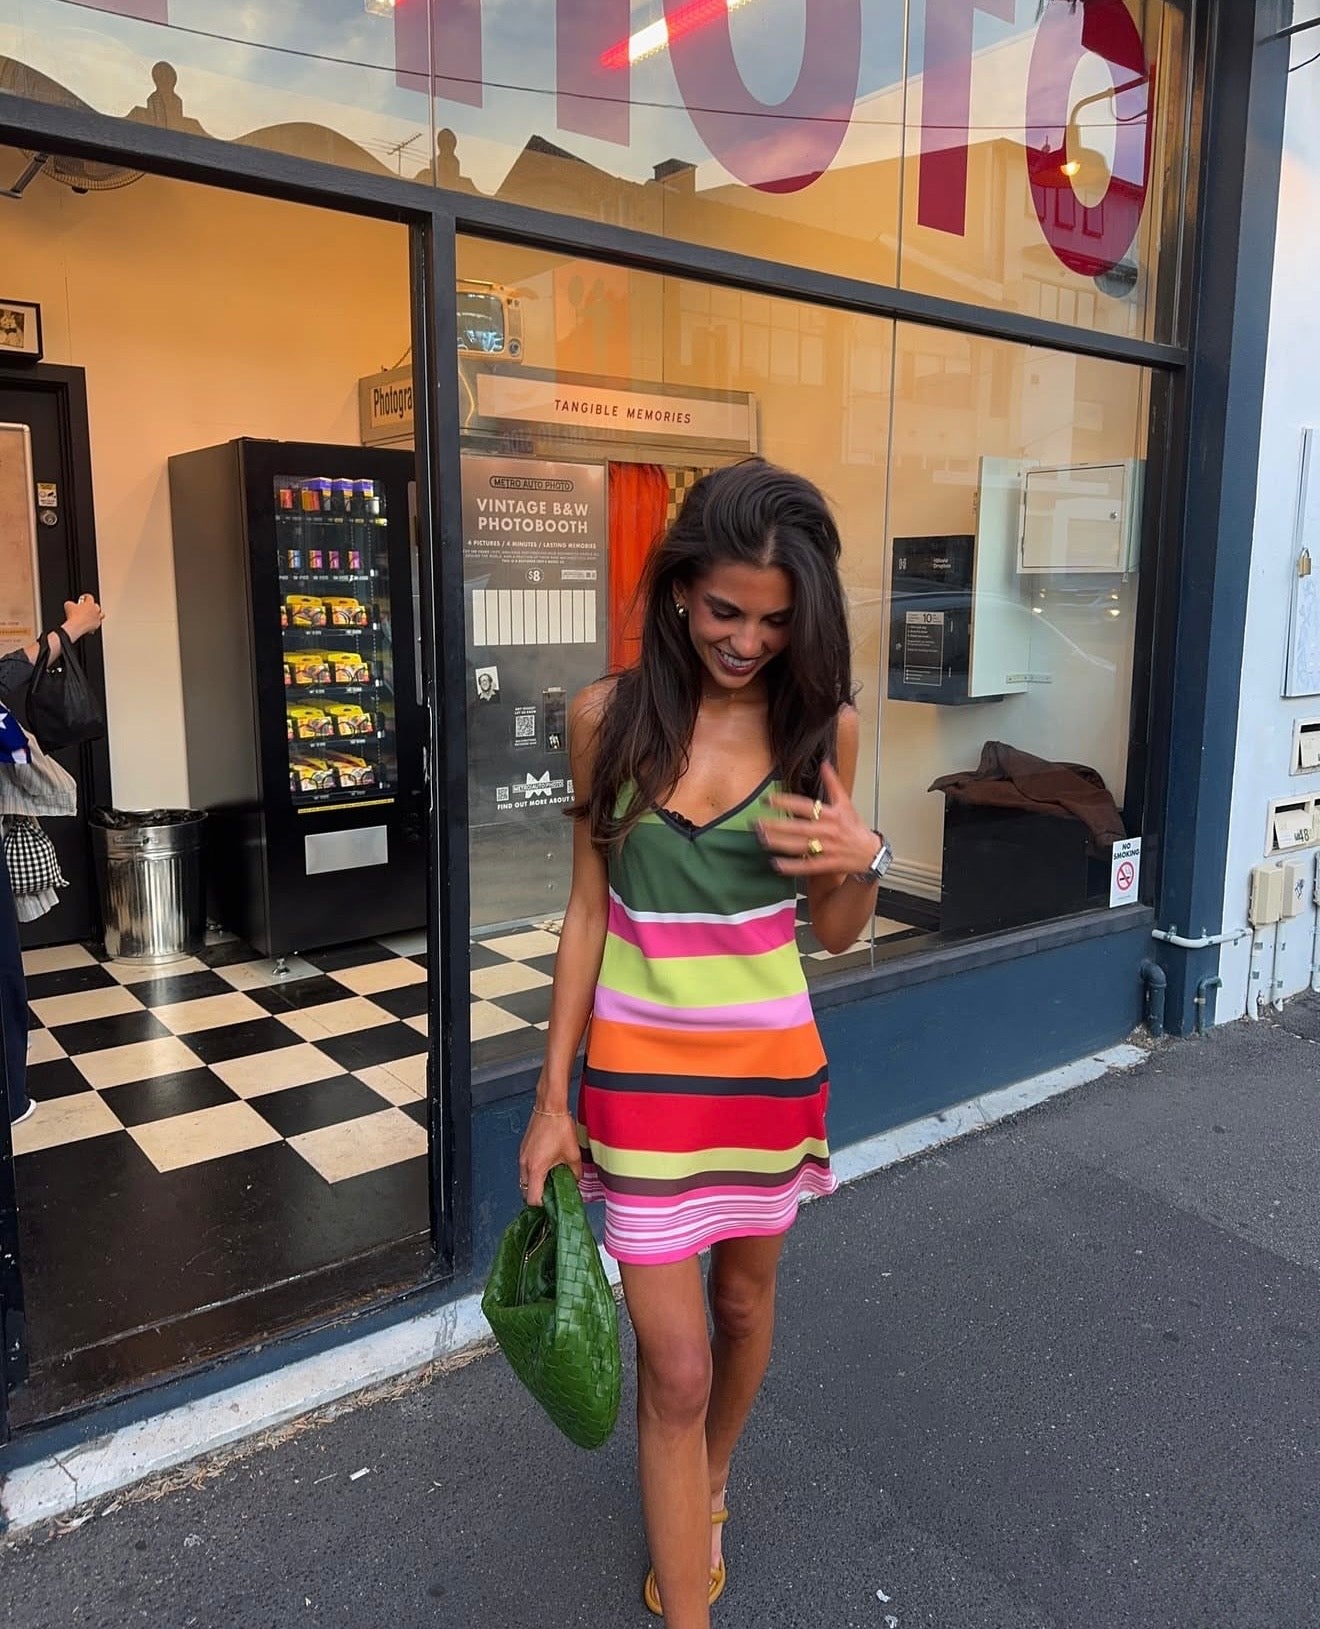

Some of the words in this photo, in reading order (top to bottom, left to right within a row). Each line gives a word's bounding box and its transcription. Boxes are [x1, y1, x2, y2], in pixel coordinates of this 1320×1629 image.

[554, 399, 619, 416] TANGIBLE
[626, 407, 692, 424] MEMORIES
[494, 478, 521, 488] METRO
[524, 480, 544, 489] AUTO
[545, 481, 570, 491] PHOTO
[476, 498, 547, 514] VINTAGE
[553, 502, 588, 516] B&W
[478, 517, 588, 533] PHOTOBOOTH
[528, 570, 541, 582] $8
[922, 613, 932, 622] 10
[1114, 849, 1140, 860] SMOKING
